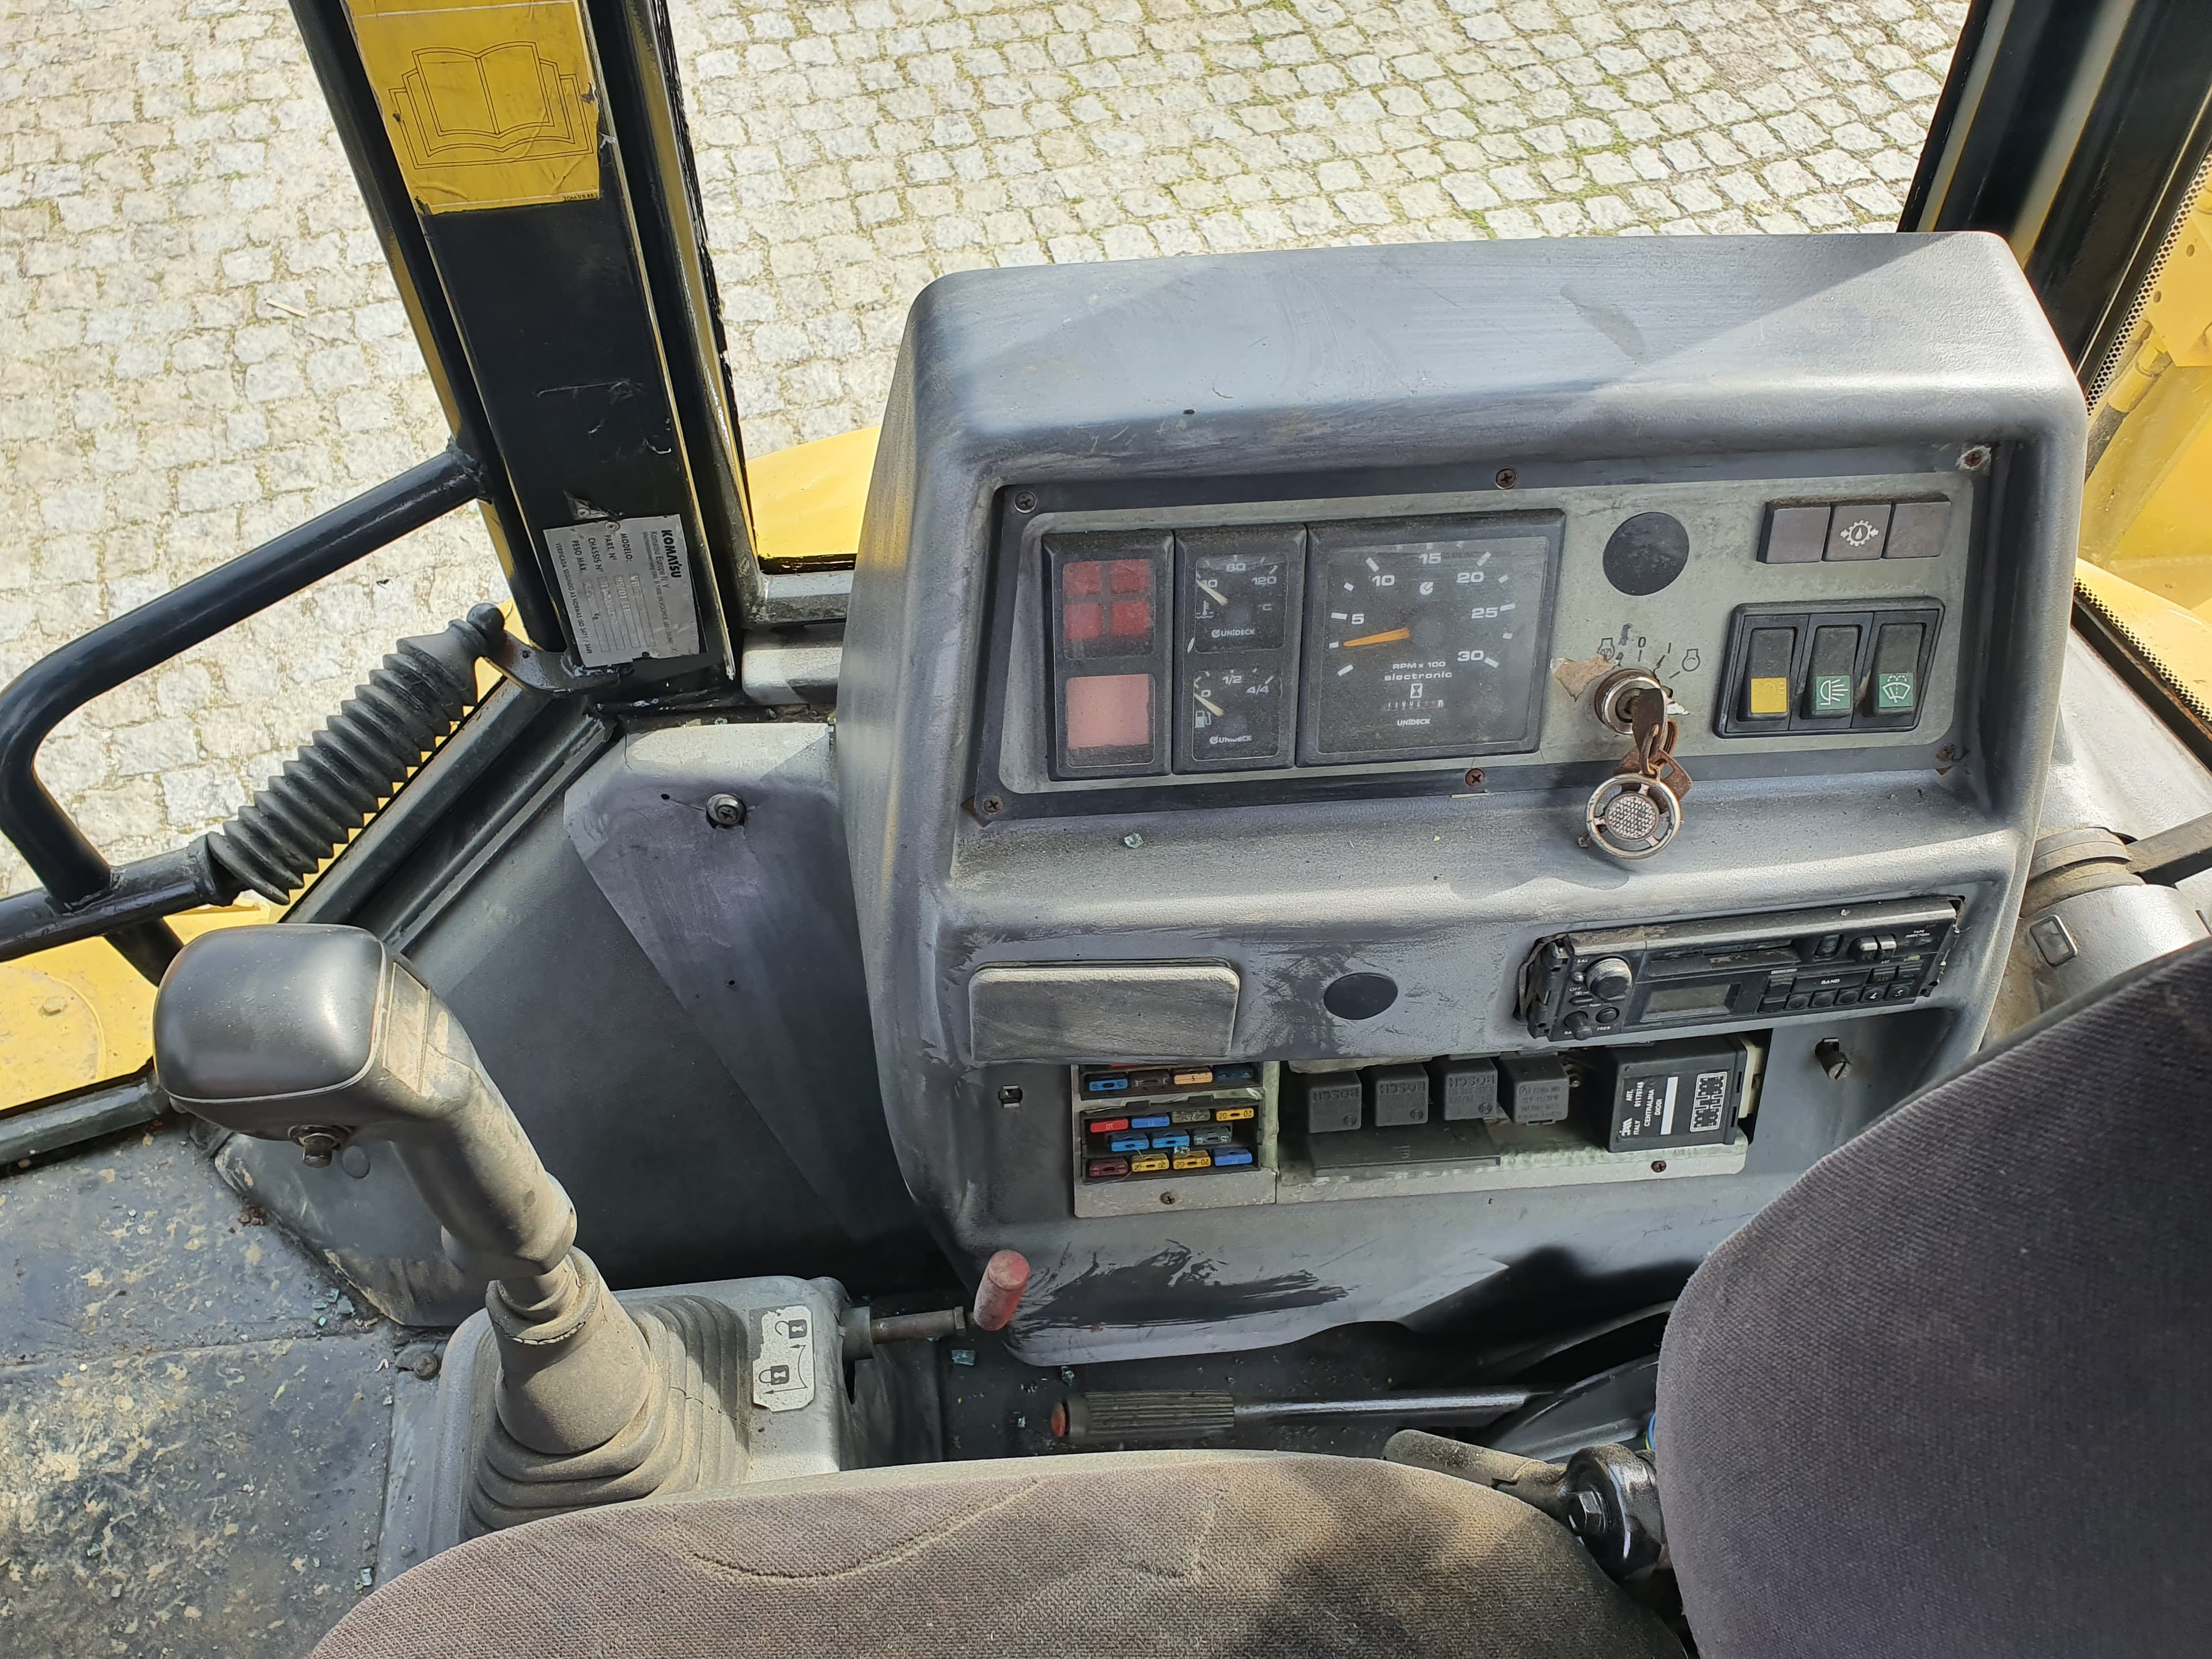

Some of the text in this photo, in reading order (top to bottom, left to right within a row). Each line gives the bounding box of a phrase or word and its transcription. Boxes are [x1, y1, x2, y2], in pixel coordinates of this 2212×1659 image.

[571, 540, 582, 555] PESO
[588, 537, 601, 563] CHASSIS
[620, 533, 632, 562] MODELO:
[650, 531, 661, 555] Komatsu
[656, 556, 665, 575] Europe
[661, 530, 682, 578] KOMATSU
[1418, 552, 1441, 565] 15
[1226, 563, 1245, 572] 80
[1251, 576, 1277, 585] 120
[1372, 575, 1395, 586] 10
[1456, 571, 1484, 583] 20
[563, 569, 574, 590] SEGUNDO
[572, 599, 582, 619] NORMAS
[1351, 613, 1364, 624] 5
[1471, 607, 1498, 619] 25
[1221, 628, 1255, 637] UNIDECK
[1457, 650, 1484, 662] 30
[1222, 675, 1242, 685] 1/2
[1384, 671, 1452, 681] electronic
[1201, 690, 1211, 698] 0
[1246, 685, 1269, 695] 4/4
[1626, 1089, 1634, 1101] ART.
[1654, 1099, 1662, 1115] DIODI
